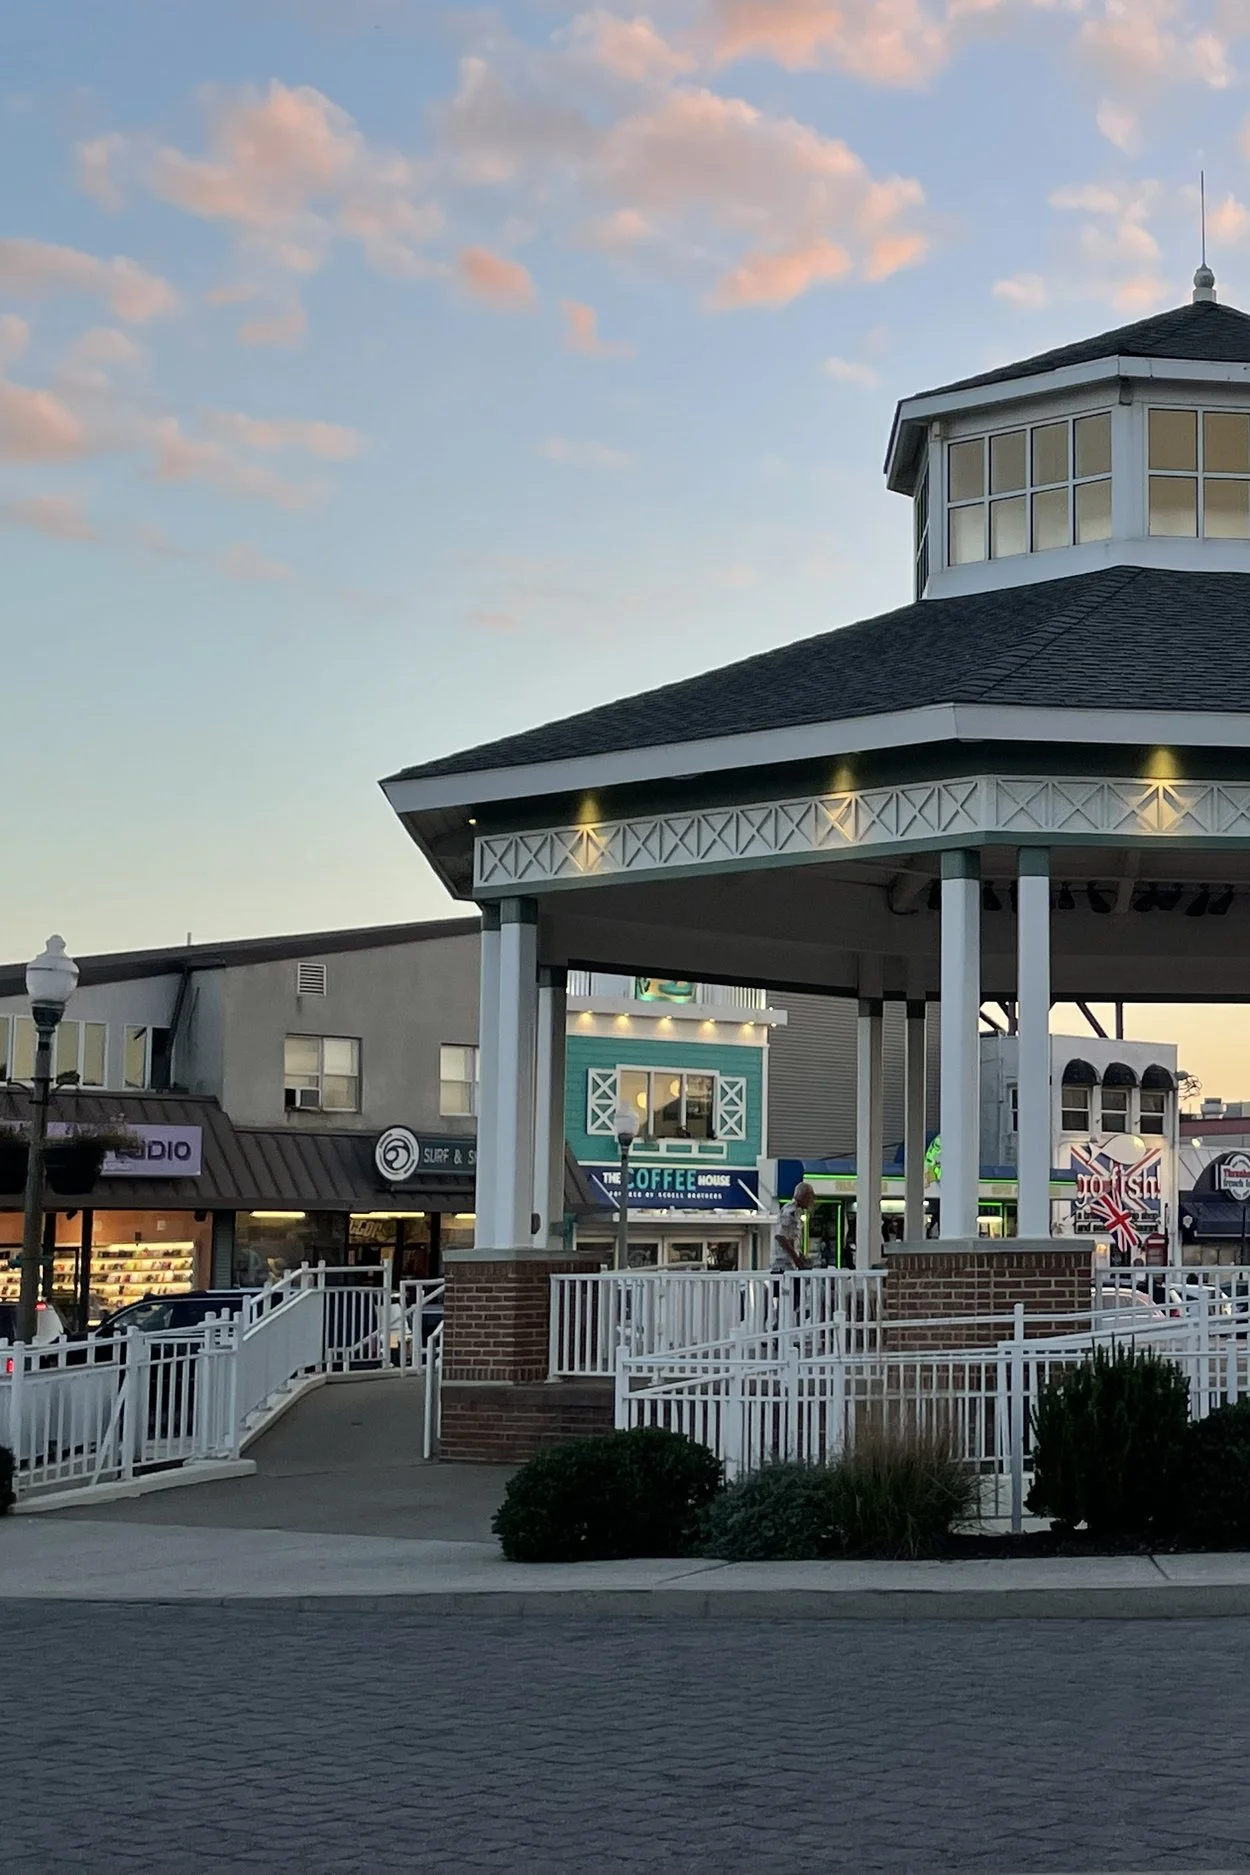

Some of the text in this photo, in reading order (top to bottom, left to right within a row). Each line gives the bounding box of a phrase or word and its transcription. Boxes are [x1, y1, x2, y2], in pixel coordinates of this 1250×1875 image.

[423, 1147, 450, 1164] SURF
[453, 1149, 463, 1165] &
[602, 1172, 621, 1184] THE
[697, 1175, 731, 1187] HOUSE
[1076, 1173, 1103, 1207] go
